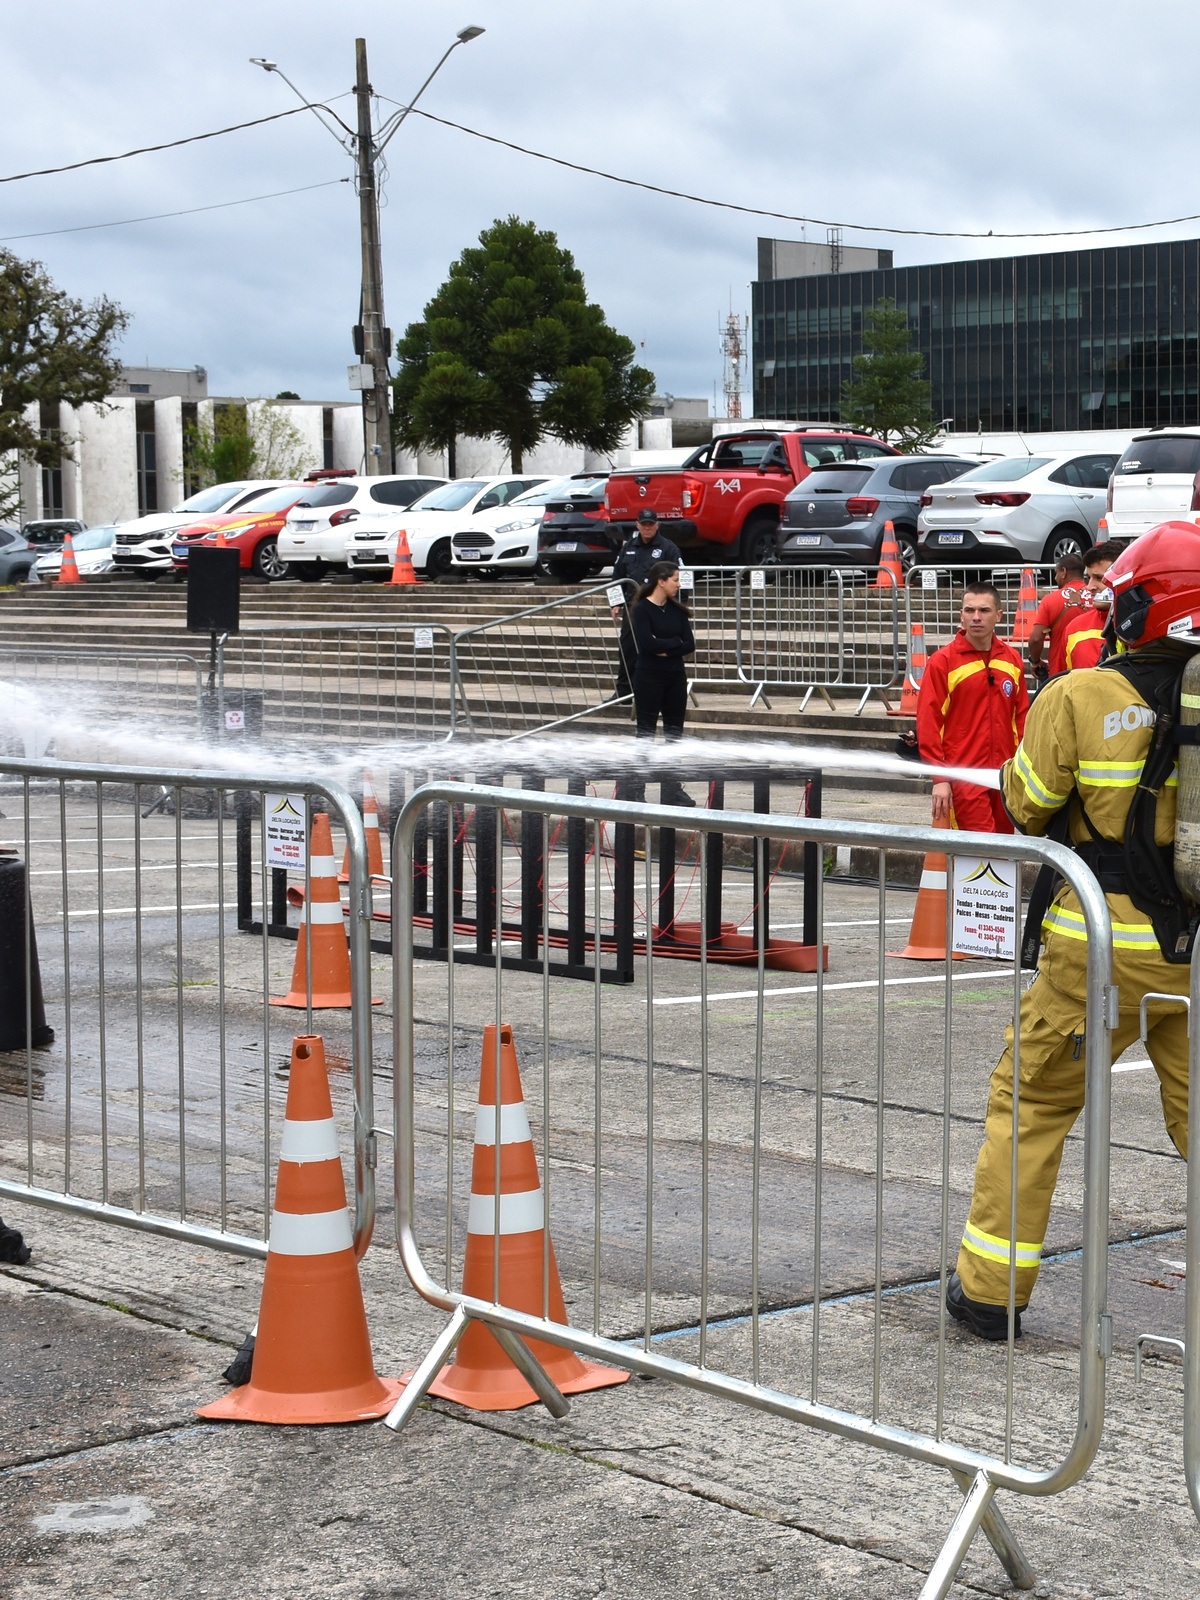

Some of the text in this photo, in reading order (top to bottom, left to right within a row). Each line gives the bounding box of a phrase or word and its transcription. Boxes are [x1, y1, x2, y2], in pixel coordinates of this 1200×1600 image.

[963, 887, 1008, 898] DELTA LOCAÇÕES
[957, 899, 1014, 913] Tendas Barracas Gradil
[975, 911, 990, 919] Mesas
[993, 913, 1014, 922] Cadeiras
